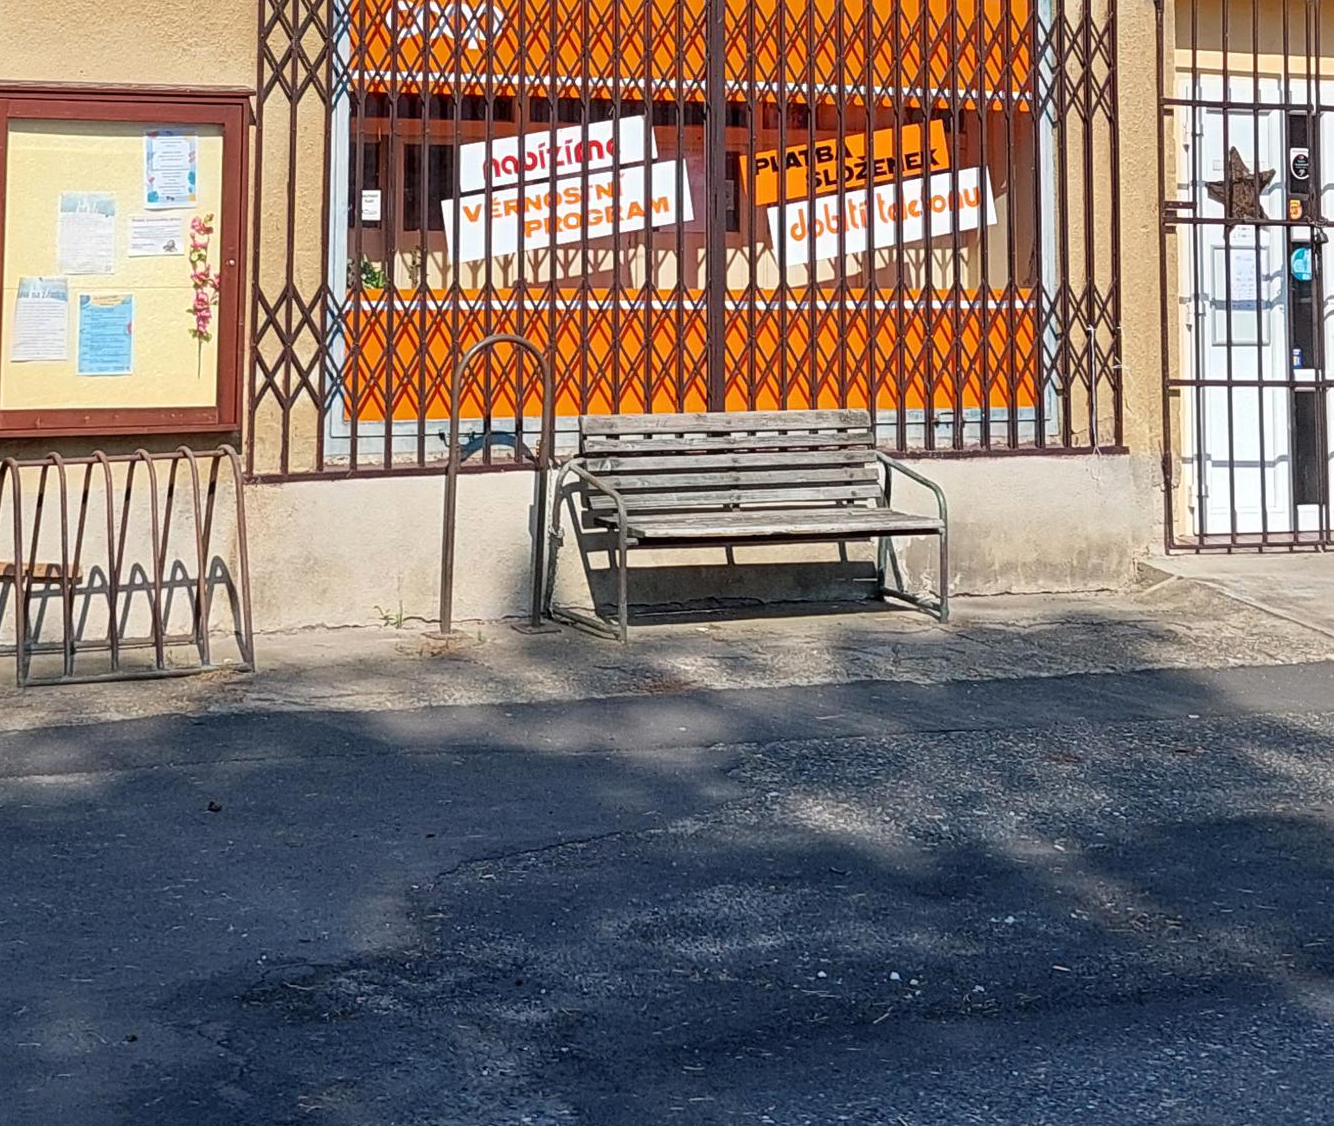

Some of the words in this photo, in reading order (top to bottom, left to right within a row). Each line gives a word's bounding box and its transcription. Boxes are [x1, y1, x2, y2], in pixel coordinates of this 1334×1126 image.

[462, 173, 625, 223] VĚRNOSN
[524, 196, 670, 238] PROGRAM
[876, 186, 980, 223] teleonu
